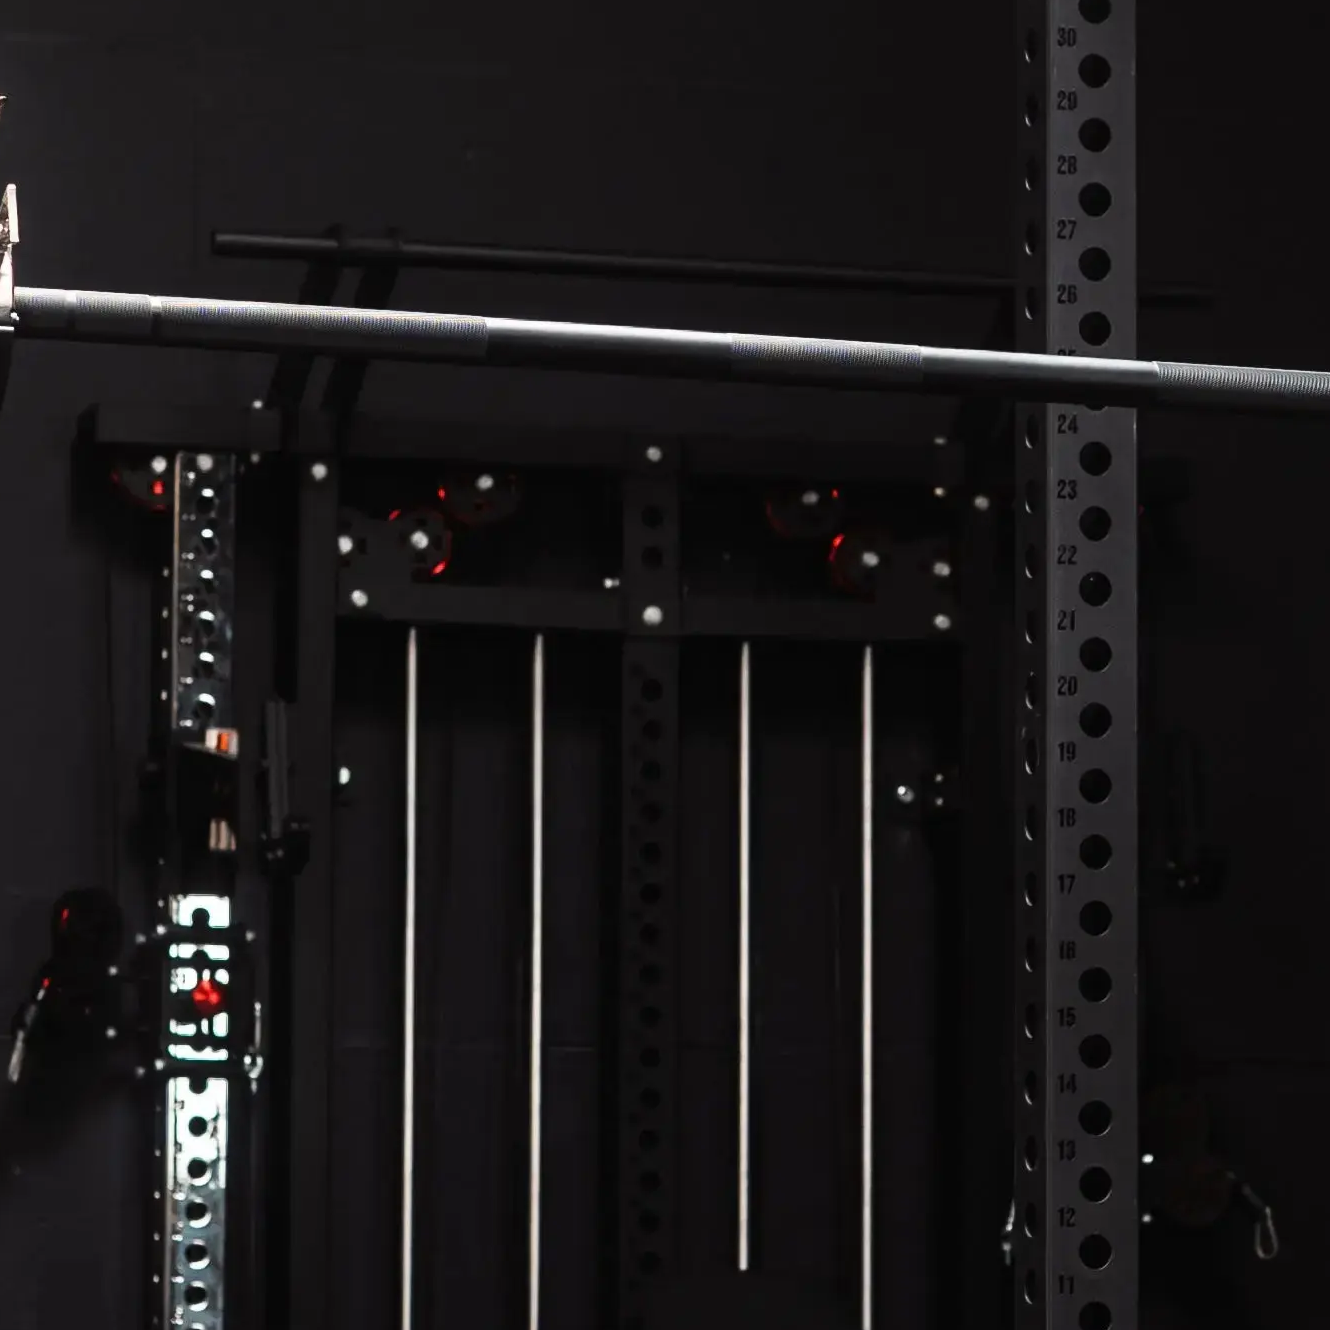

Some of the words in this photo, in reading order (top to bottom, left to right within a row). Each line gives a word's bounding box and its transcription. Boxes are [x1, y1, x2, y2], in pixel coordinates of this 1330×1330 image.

[1056, 26, 1078, 48] 30
[1056, 154, 1078, 176] 28
[1056, 219, 1078, 241] 27
[1057, 283, 1078, 305] 26
[1057, 413, 1079, 435] 24
[1056, 478, 1078, 501] 23
[1056, 544, 1078, 566] 22
[1057, 609, 1076, 632] 21
[1057, 675, 1078, 697] 20
[1058, 740, 1077, 763] 19
[1057, 807, 1077, 828] 18
[1057, 873, 1076, 895] 17
[1058, 940, 1077, 961] 16
[1056, 1006, 1077, 1028] 15
[1057, 1073, 1078, 1095] 14
[1057, 1139, 1077, 1162] 13
[1057, 1206, 1076, 1228] 12
[1058, 1274, 1075, 1295] 11
